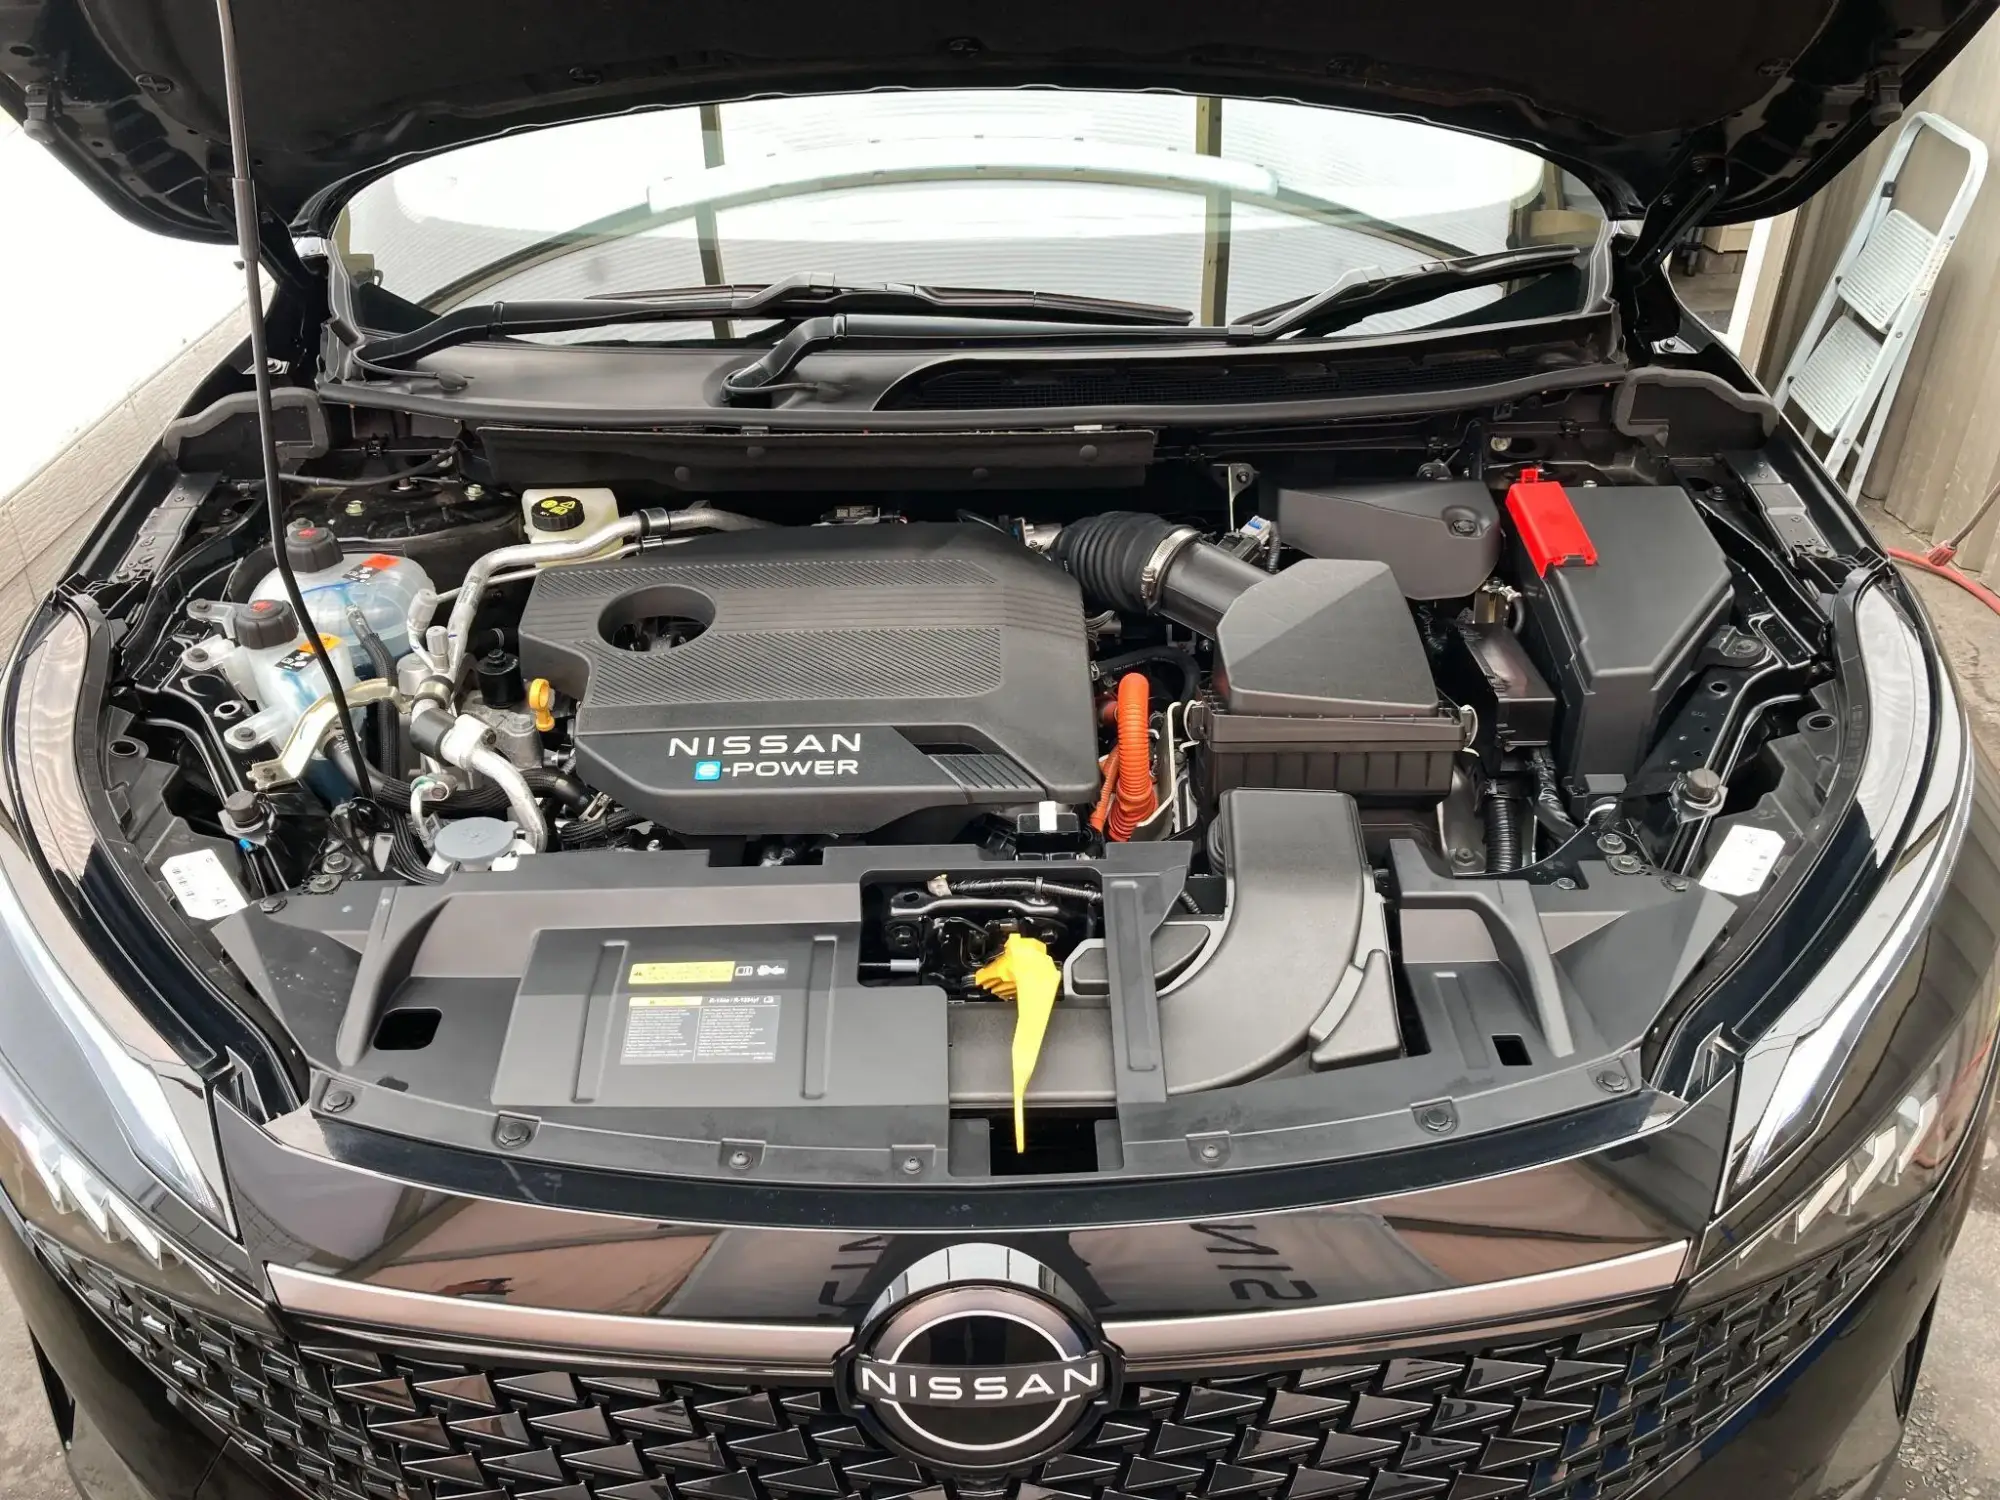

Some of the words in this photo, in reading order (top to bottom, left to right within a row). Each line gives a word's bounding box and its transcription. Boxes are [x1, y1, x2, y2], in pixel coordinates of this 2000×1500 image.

[668, 733, 861, 757] NISSAN
[695, 760, 859, 780] e-POWER
[861, 1363, 1098, 1400] NISSAN
